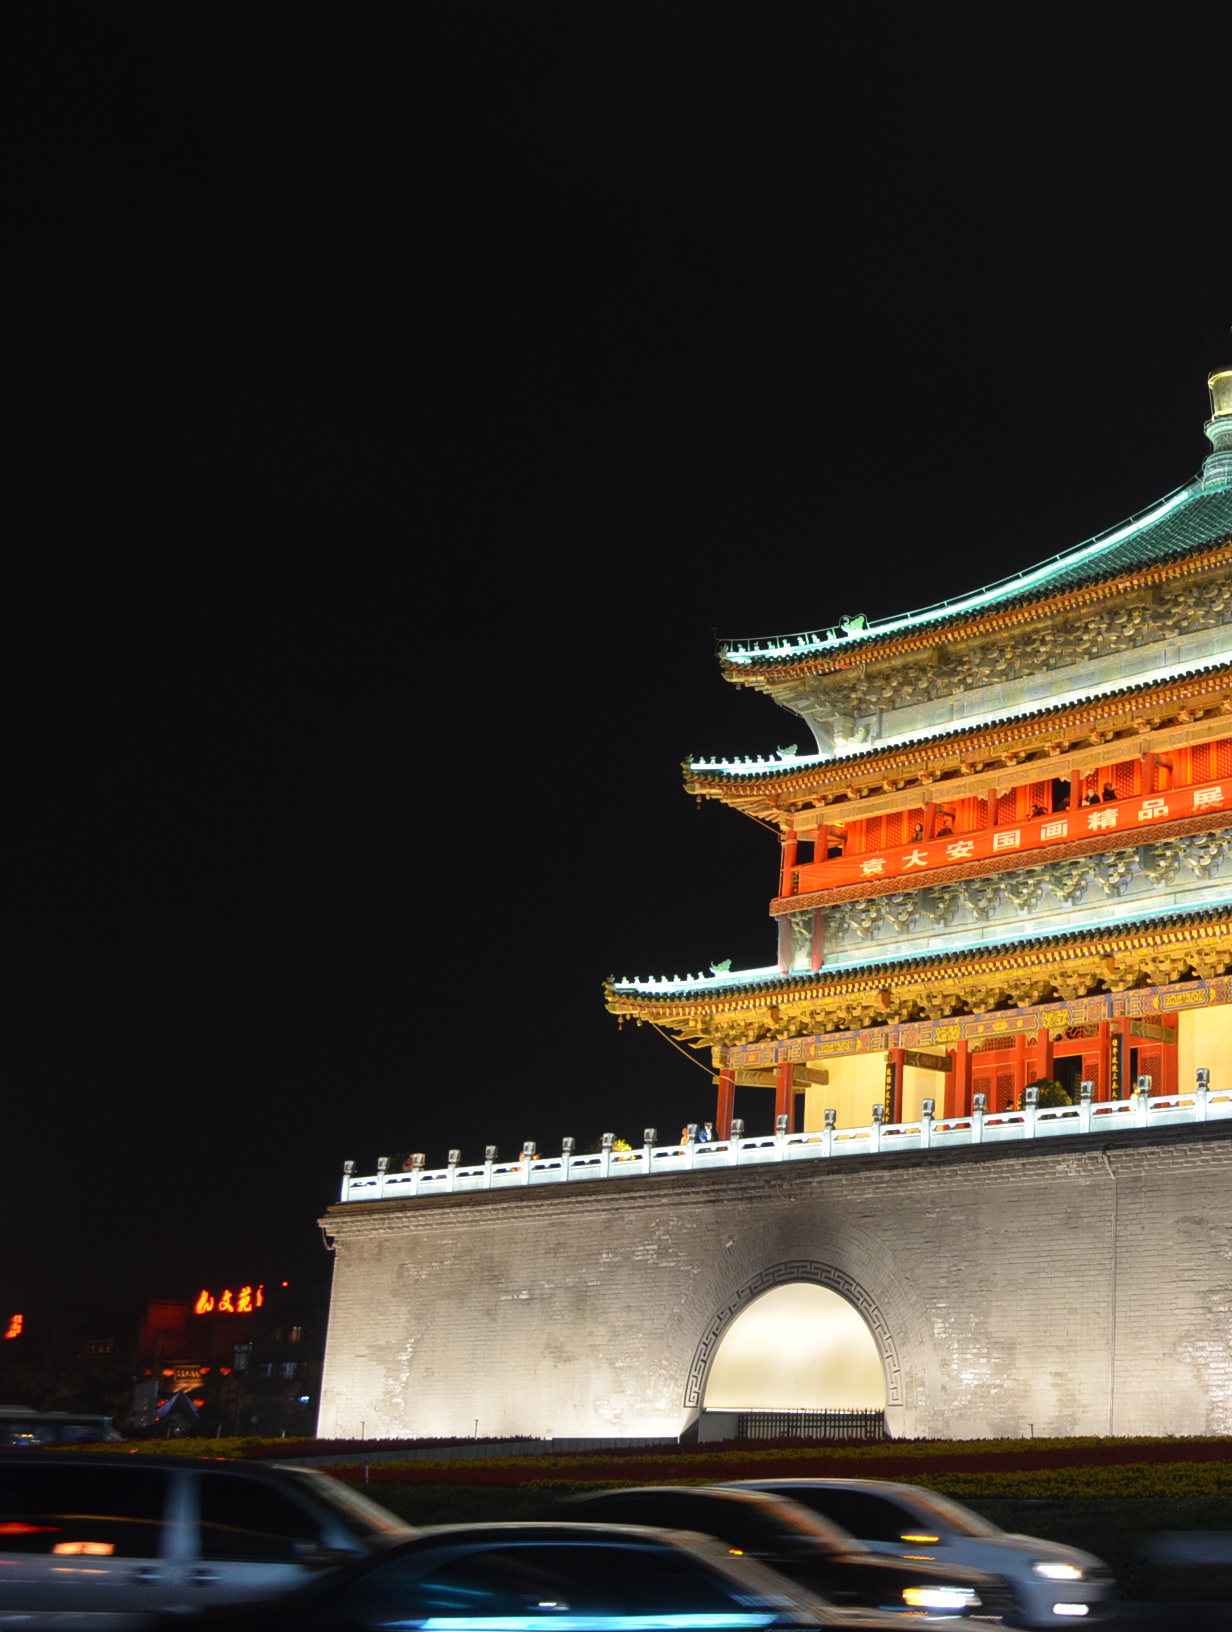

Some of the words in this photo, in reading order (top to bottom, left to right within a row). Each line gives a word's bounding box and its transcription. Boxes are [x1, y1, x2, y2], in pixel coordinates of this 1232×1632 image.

[859, 786, 1224, 878] 袁大安国画精品展
